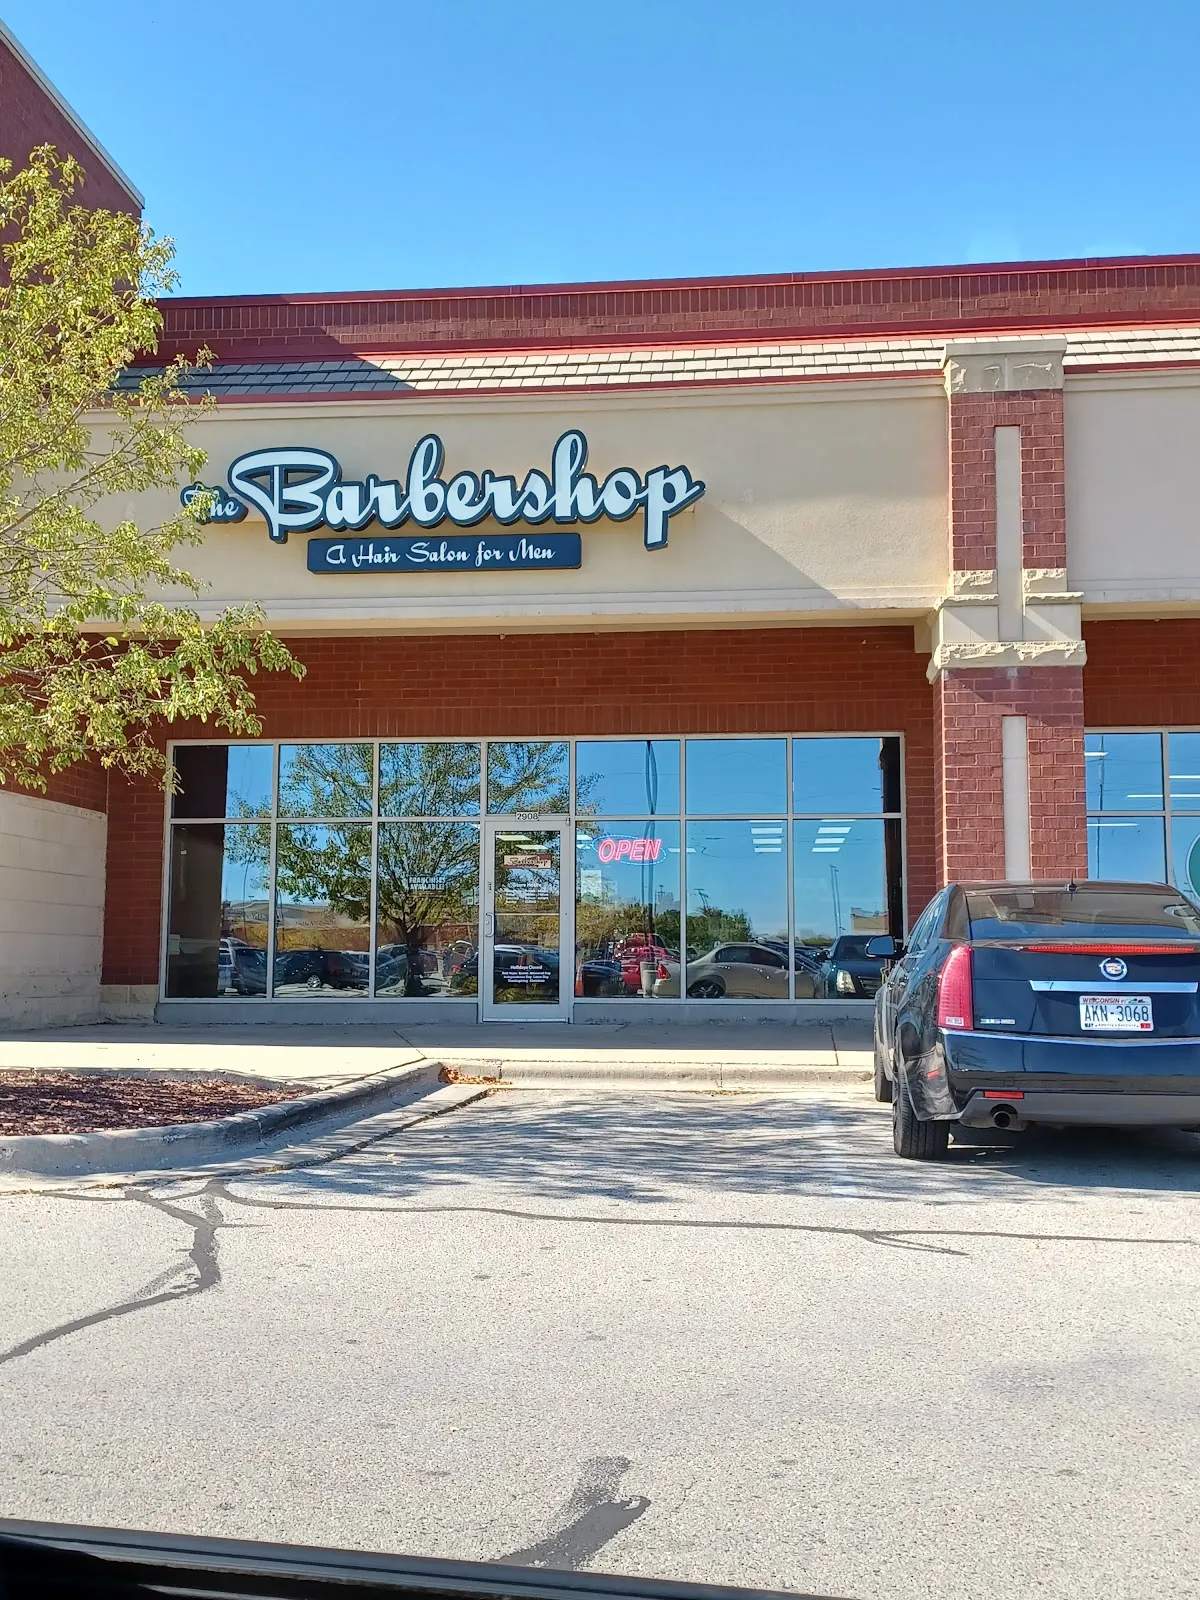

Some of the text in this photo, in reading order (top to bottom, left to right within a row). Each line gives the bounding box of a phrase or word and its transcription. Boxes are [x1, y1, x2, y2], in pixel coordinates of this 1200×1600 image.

[231, 432, 703, 545] Barbershop
[326, 537, 556, 568] A Hair Salon for Men
[598, 838, 662, 862] OPEN
[1085, 1005, 1149, 1022] AKN-3068
